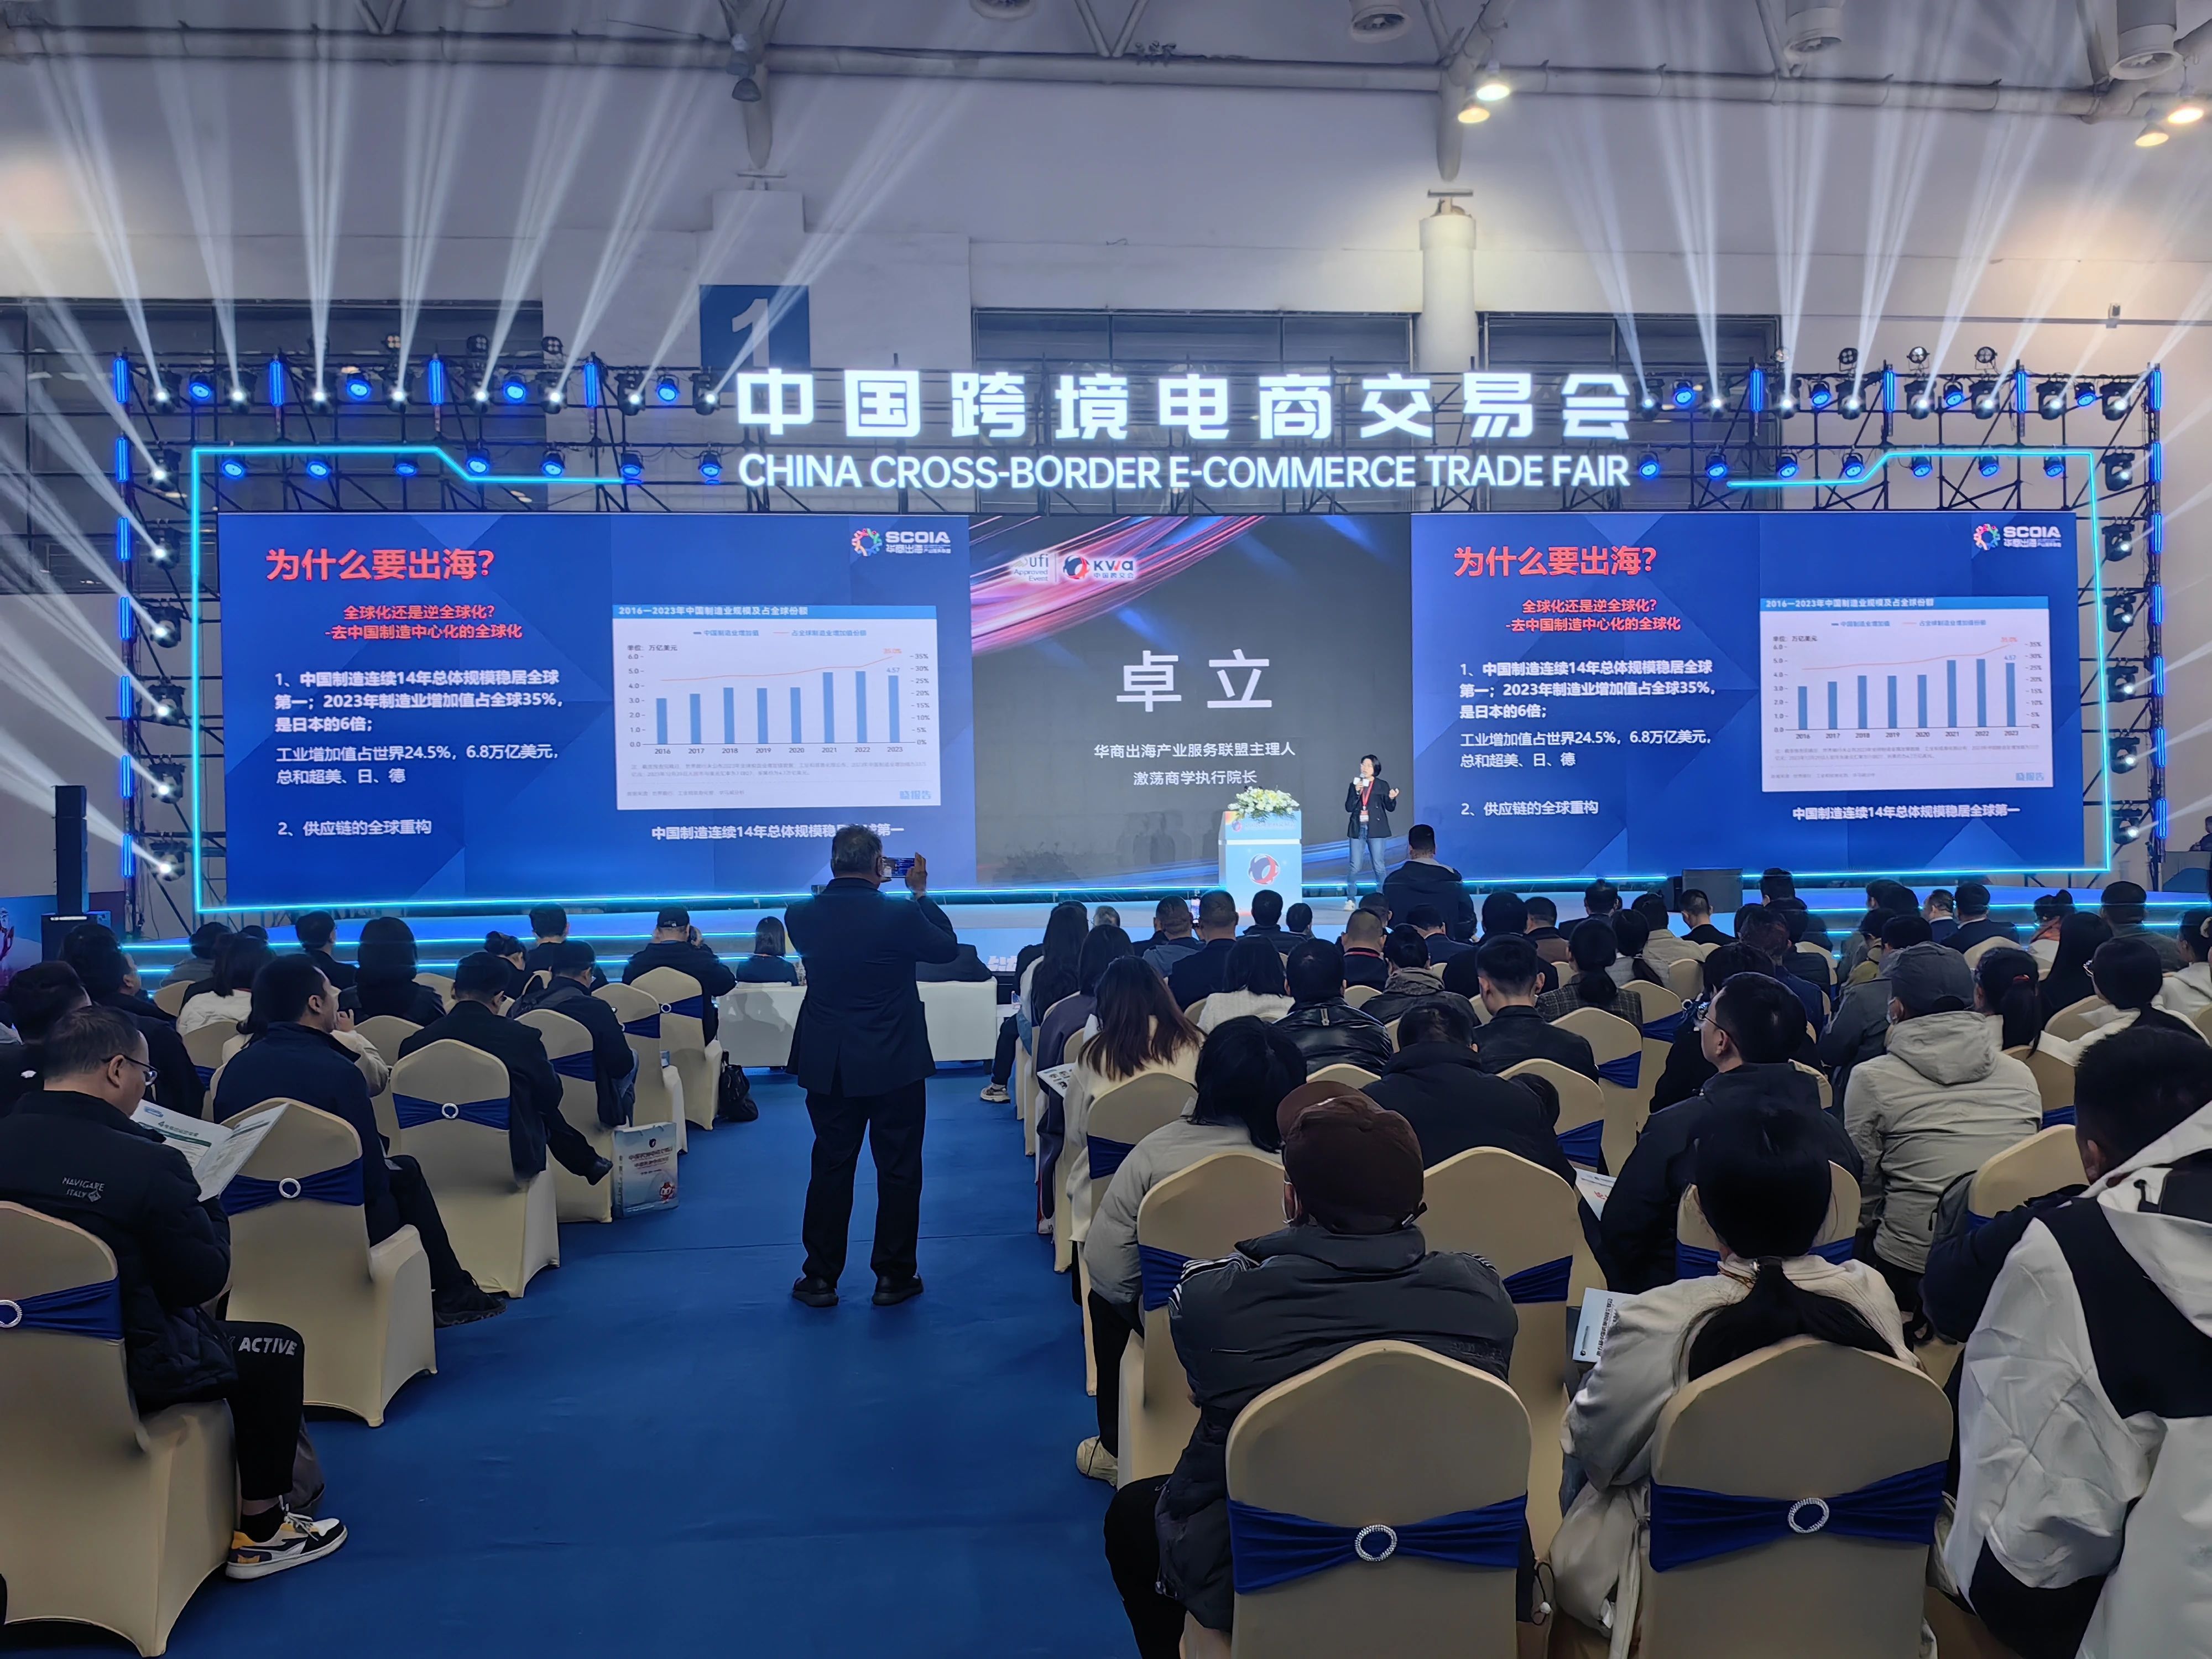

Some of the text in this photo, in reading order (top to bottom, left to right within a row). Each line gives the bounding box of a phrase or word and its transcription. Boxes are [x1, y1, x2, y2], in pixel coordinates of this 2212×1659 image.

[732, 298, 770, 367] 1
[737, 368, 1630, 440] 中国跨境电商交易会
[738, 454, 1630, 489] CHINA CROSS-BORDER E-COMMERCE TRADE FAIR
[885, 531, 951, 543] SCOIA
[2003, 526, 2061, 538] SCOIA
[266, 548, 495, 581] 为什么要出海？
[1029, 554, 1048, 567] ufi
[1454, 545, 1657, 576] 为什么要出海？
[344, 604, 495, 620] 全球化还是逆全球化？
[1522, 599, 1657, 614] 全球化还是逆全球化？
[325, 624, 523, 640] -去中国制造中心化的全球化
[1505, 617, 1681, 632] -去中国制造中心化的全球化
[1116, 649, 1272, 712] 卓立
[1094, 742, 1296, 759] 华商出海产业服务联盟主理人
[1460, 752, 1576, 768] 总和超美、日、德
[276, 768, 406, 785] 总和超美、日、德
[1133, 770, 1257, 786] 激荡商学执行院长
[1460, 801, 1599, 817] 2、供应链的全球重构
[1792, 805, 2021, 820] 中国制造连续14年总体规模稳居全球第一
[277, 820, 432, 837] 2、供应链的全球重构
[238, 1337, 298, 1356] ACTIVE
